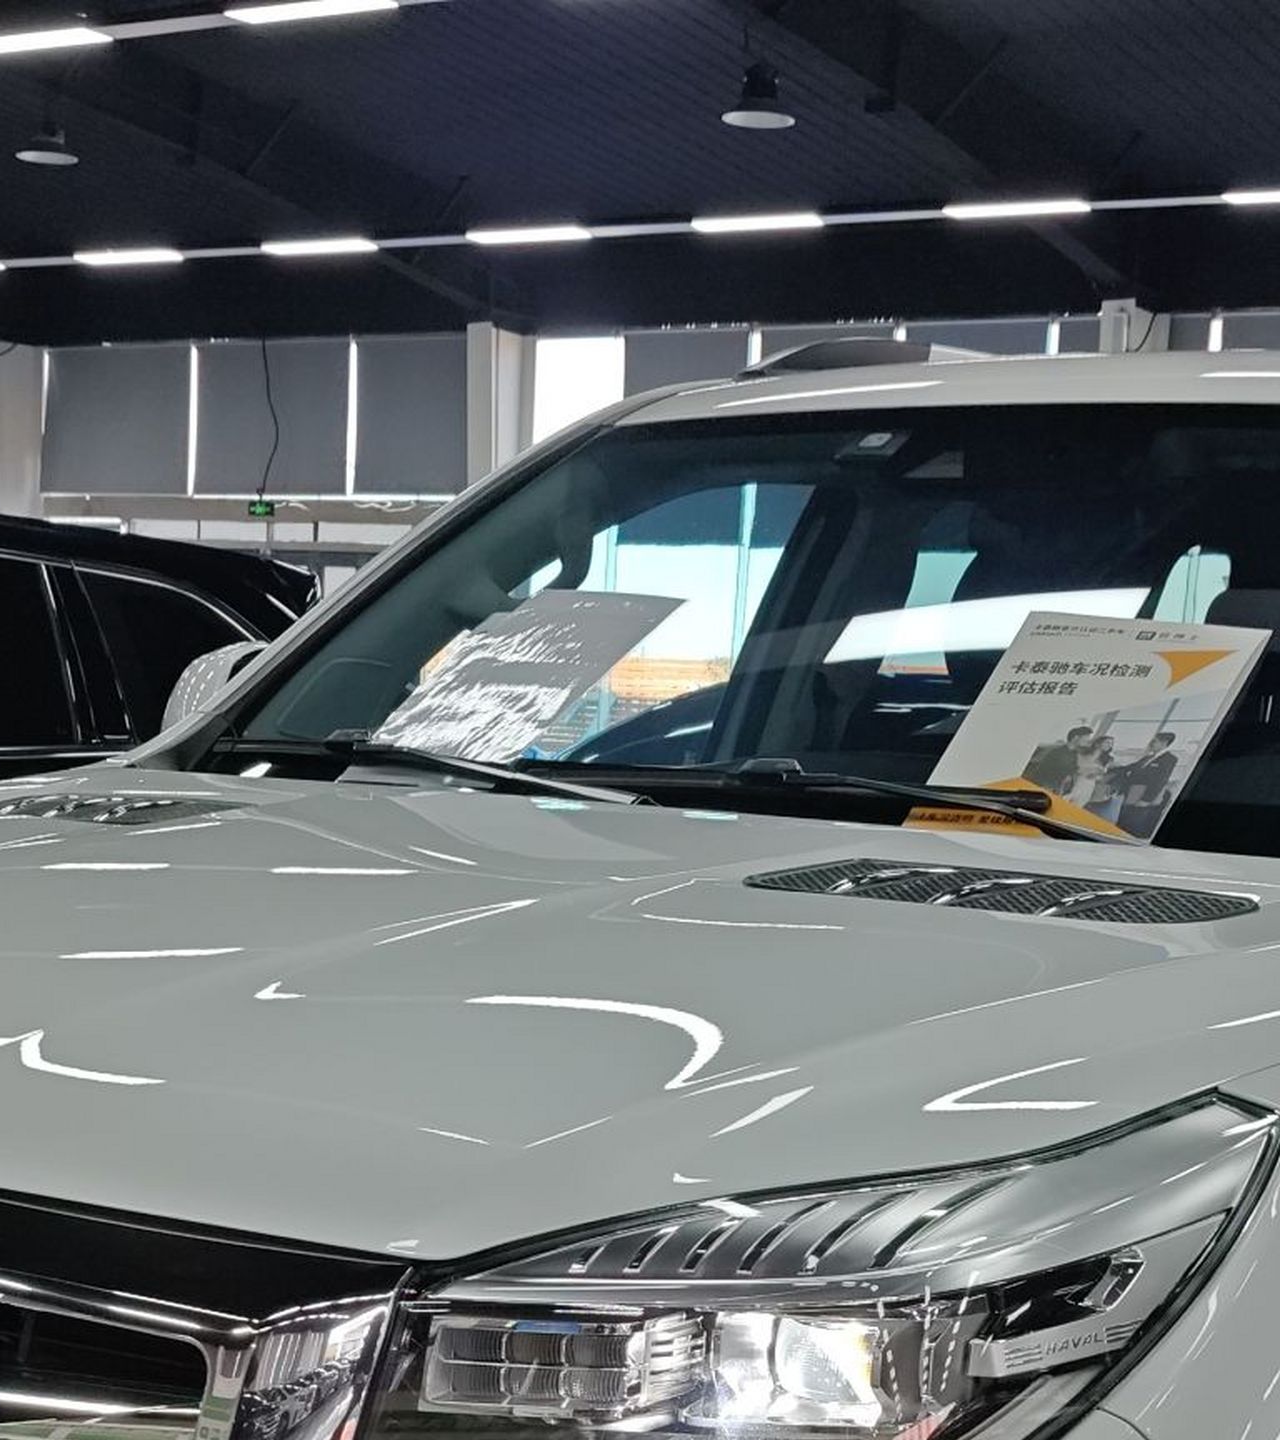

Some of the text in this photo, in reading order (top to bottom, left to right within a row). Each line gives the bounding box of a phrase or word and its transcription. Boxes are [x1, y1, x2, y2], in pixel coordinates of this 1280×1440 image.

[1011, 661, 1154, 678] 卡泰驰车况检测
[998, 680, 1078, 696] 评估报告
[1047, 1333, 1104, 1356] HAVAL
